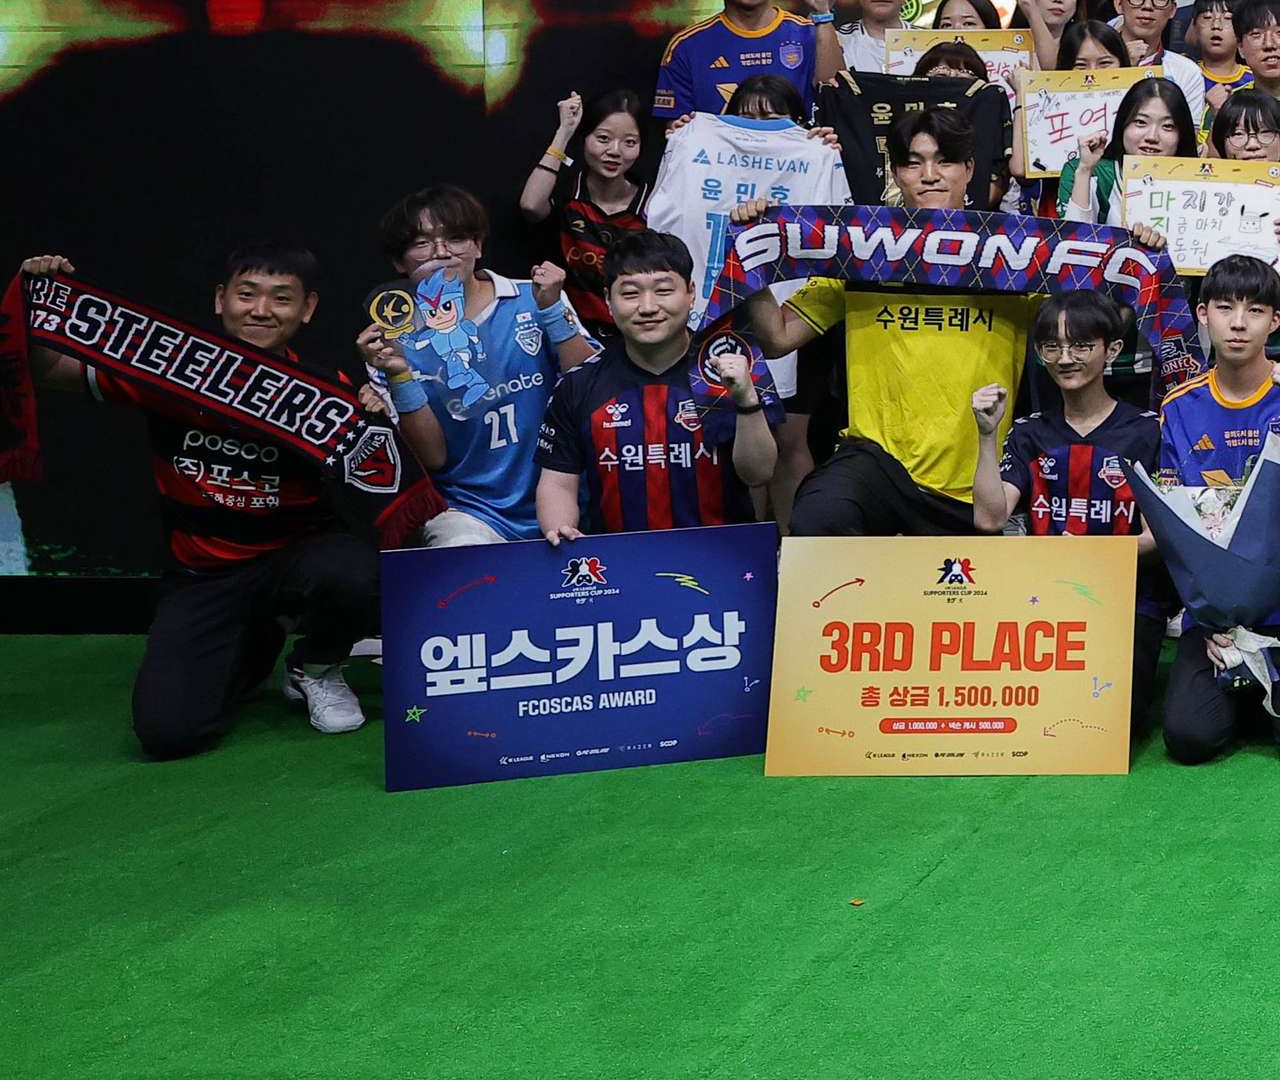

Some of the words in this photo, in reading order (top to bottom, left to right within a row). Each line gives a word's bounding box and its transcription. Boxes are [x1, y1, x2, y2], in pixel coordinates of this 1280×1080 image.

[717, 151, 811, 175] LASHEVAN
[1150, 190, 1236, 217] 마지강
[734, 221, 1042, 273] SUWON
[875, 304, 994, 333] 수원특례시
[64, 292, 357, 448] STEELERS
[483, 402, 521, 452] 27
[183, 429, 280, 464] posco
[597, 441, 719, 471] 수원특례시
[1031, 494, 1136, 524] 수원특례시
[420, 610, 746, 697] 엪스카스상
[819, 619, 915, 674] 3RD
[928, 619, 1088, 673] PLACE
[517, 694, 594, 718] FCOSCAS
[598, 688, 657, 710] AWARD
[860, 685, 881, 708] 총
[888, 685, 930, 708] 상금
[936, 685, 1040, 708] 1,500,000
